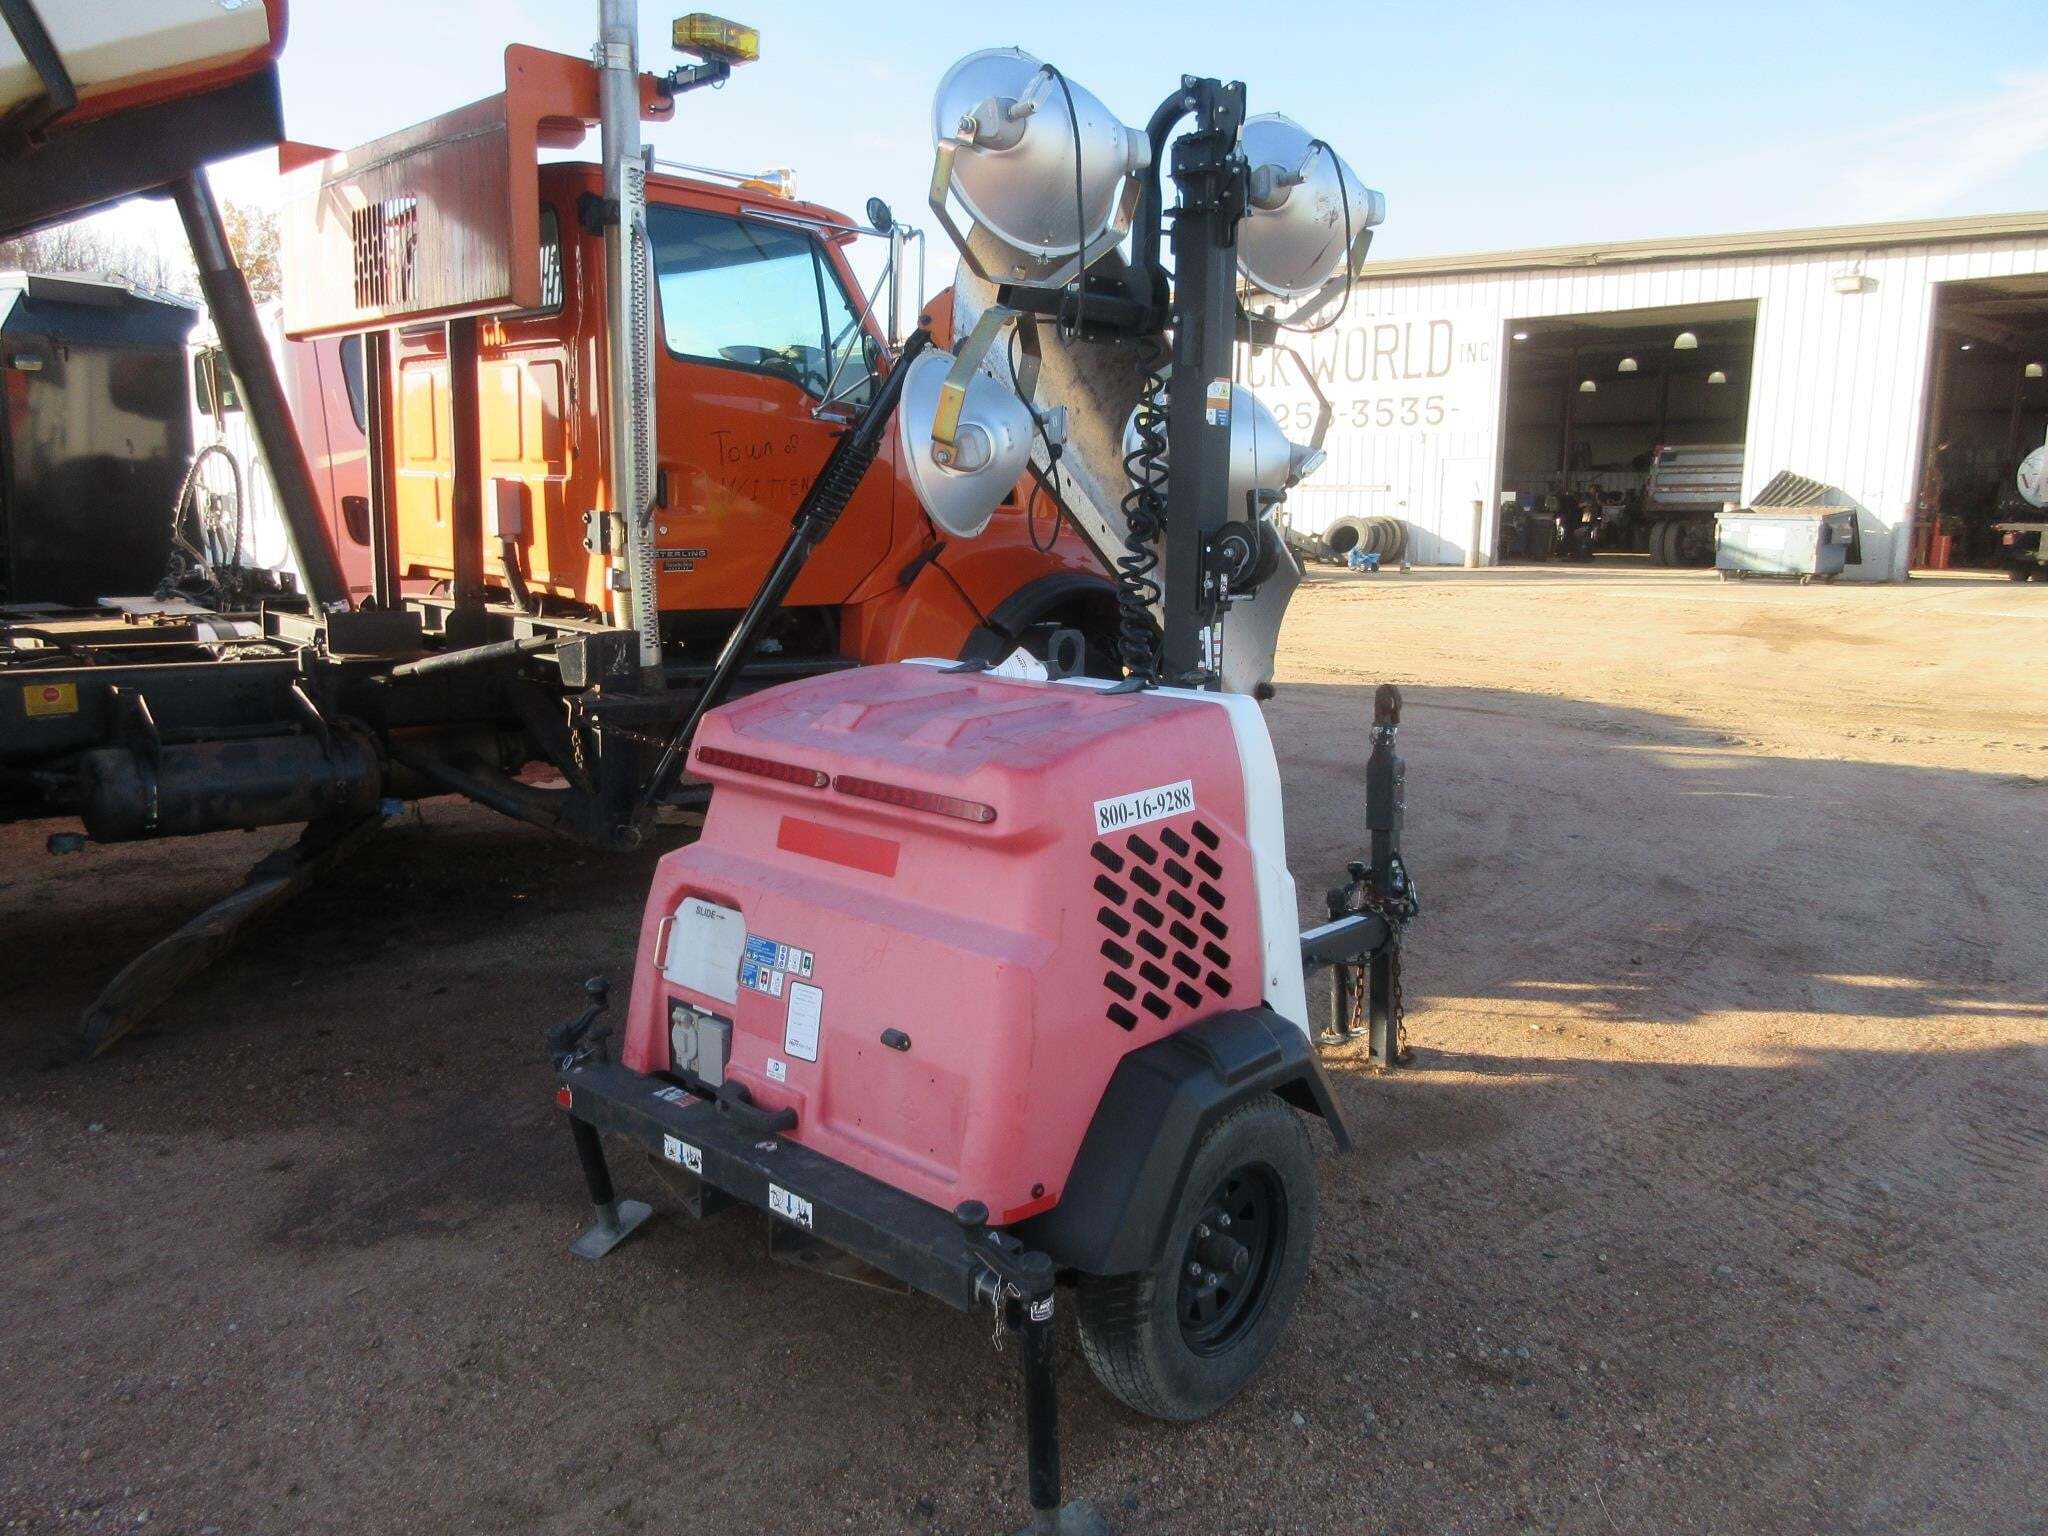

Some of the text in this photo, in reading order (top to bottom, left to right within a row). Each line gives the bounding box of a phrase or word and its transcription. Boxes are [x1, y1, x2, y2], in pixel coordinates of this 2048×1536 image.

[1311, 319, 1453, 384] WORLD
[1459, 341, 1489, 363] INC
[711, 430, 773, 465] Town
[1099, 786, 1191, 829] 800-16-9288
[695, 905, 716, 919] SLIDE
